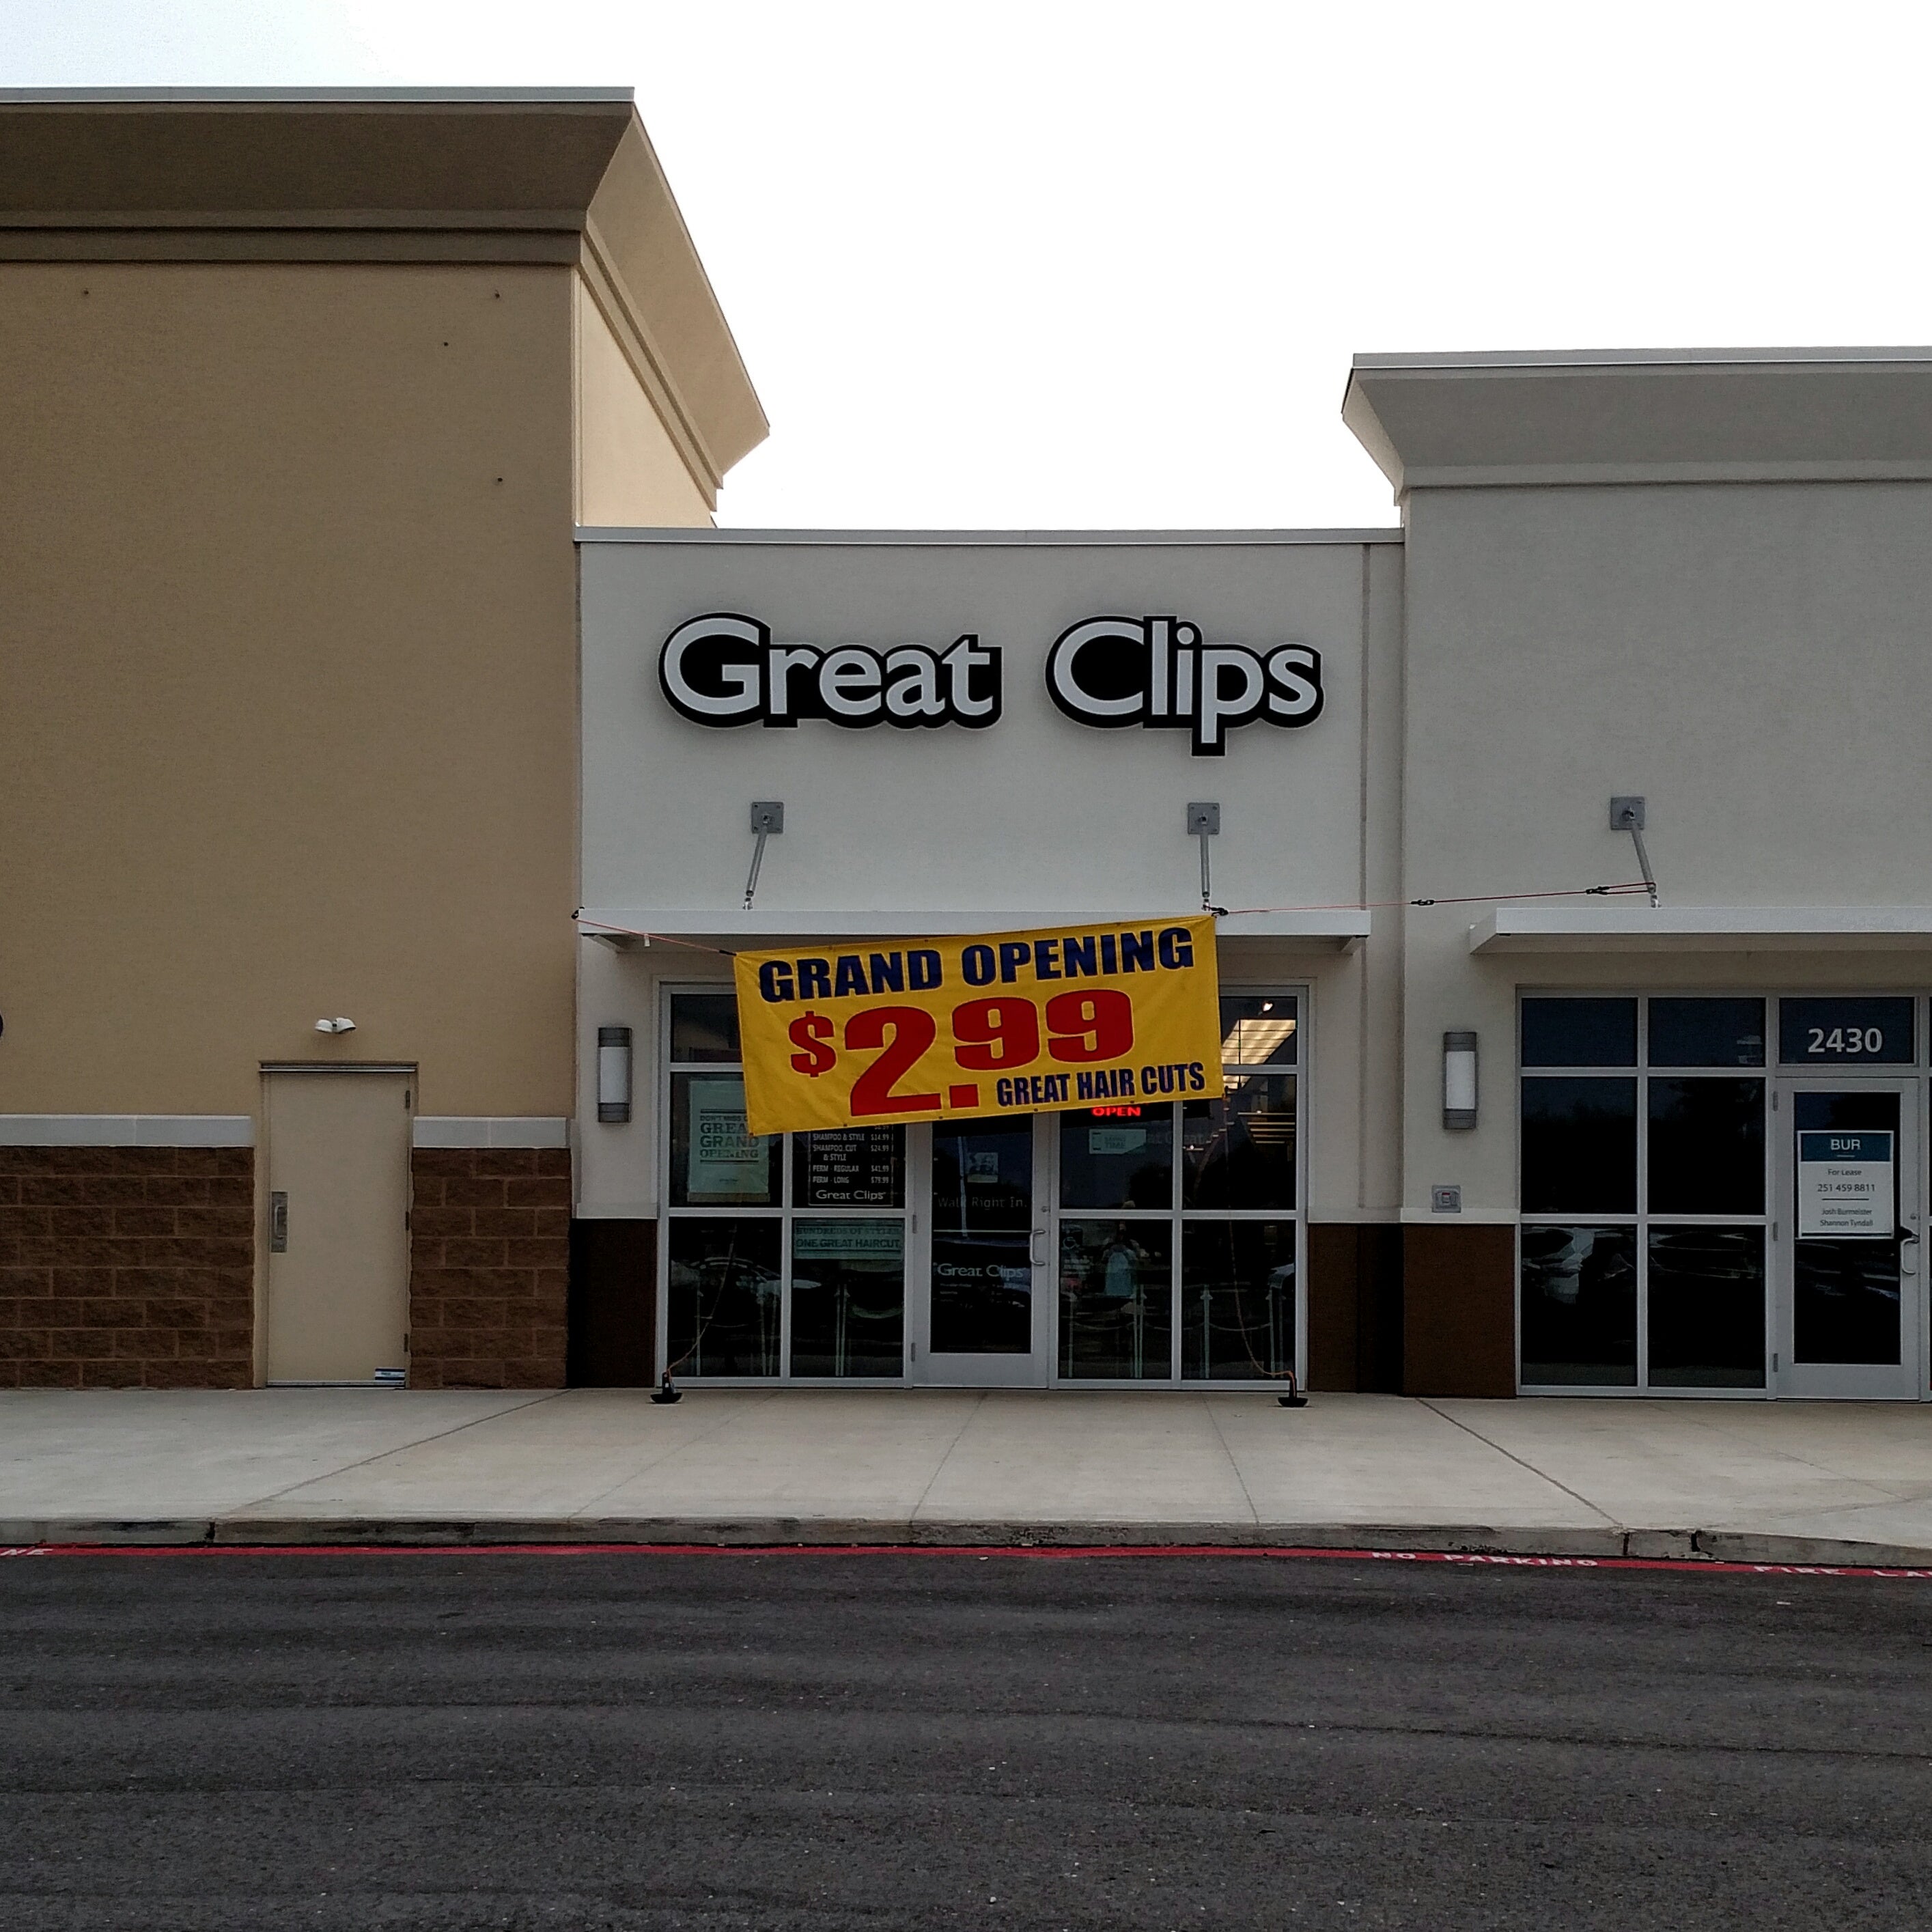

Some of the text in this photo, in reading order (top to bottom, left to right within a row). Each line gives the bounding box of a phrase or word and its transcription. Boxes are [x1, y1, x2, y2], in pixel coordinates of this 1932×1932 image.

[662, 615, 1320, 750] Great Clips
[758, 927, 1194, 1004] GRAND OPENING
[1808, 1028, 1883, 1053] 2430
[788, 988, 1135, 1117] $2.99
[996, 1062, 1206, 1107] GREAT HAIR CUTS
[1093, 1106, 1142, 1117] OPEN
[701, 1122, 749, 1134] GREA
[700, 1136, 760, 1148] GRAND
[813, 1133, 841, 1141] SHAMPOO
[815, 1190, 885, 1201] Great Clips
[1817, 1184, 1876, 1192] 251 459 8811
[938, 1196, 966, 1208] Wal
[972, 1196, 1005, 1211] Right
[796, 1239, 819, 1248] ONE
[820, 1239, 852, 1248] GREAT
[937, 1263, 1024, 1281] Great Clips
[1371, 1551, 1599, 1567] NO PARKING
